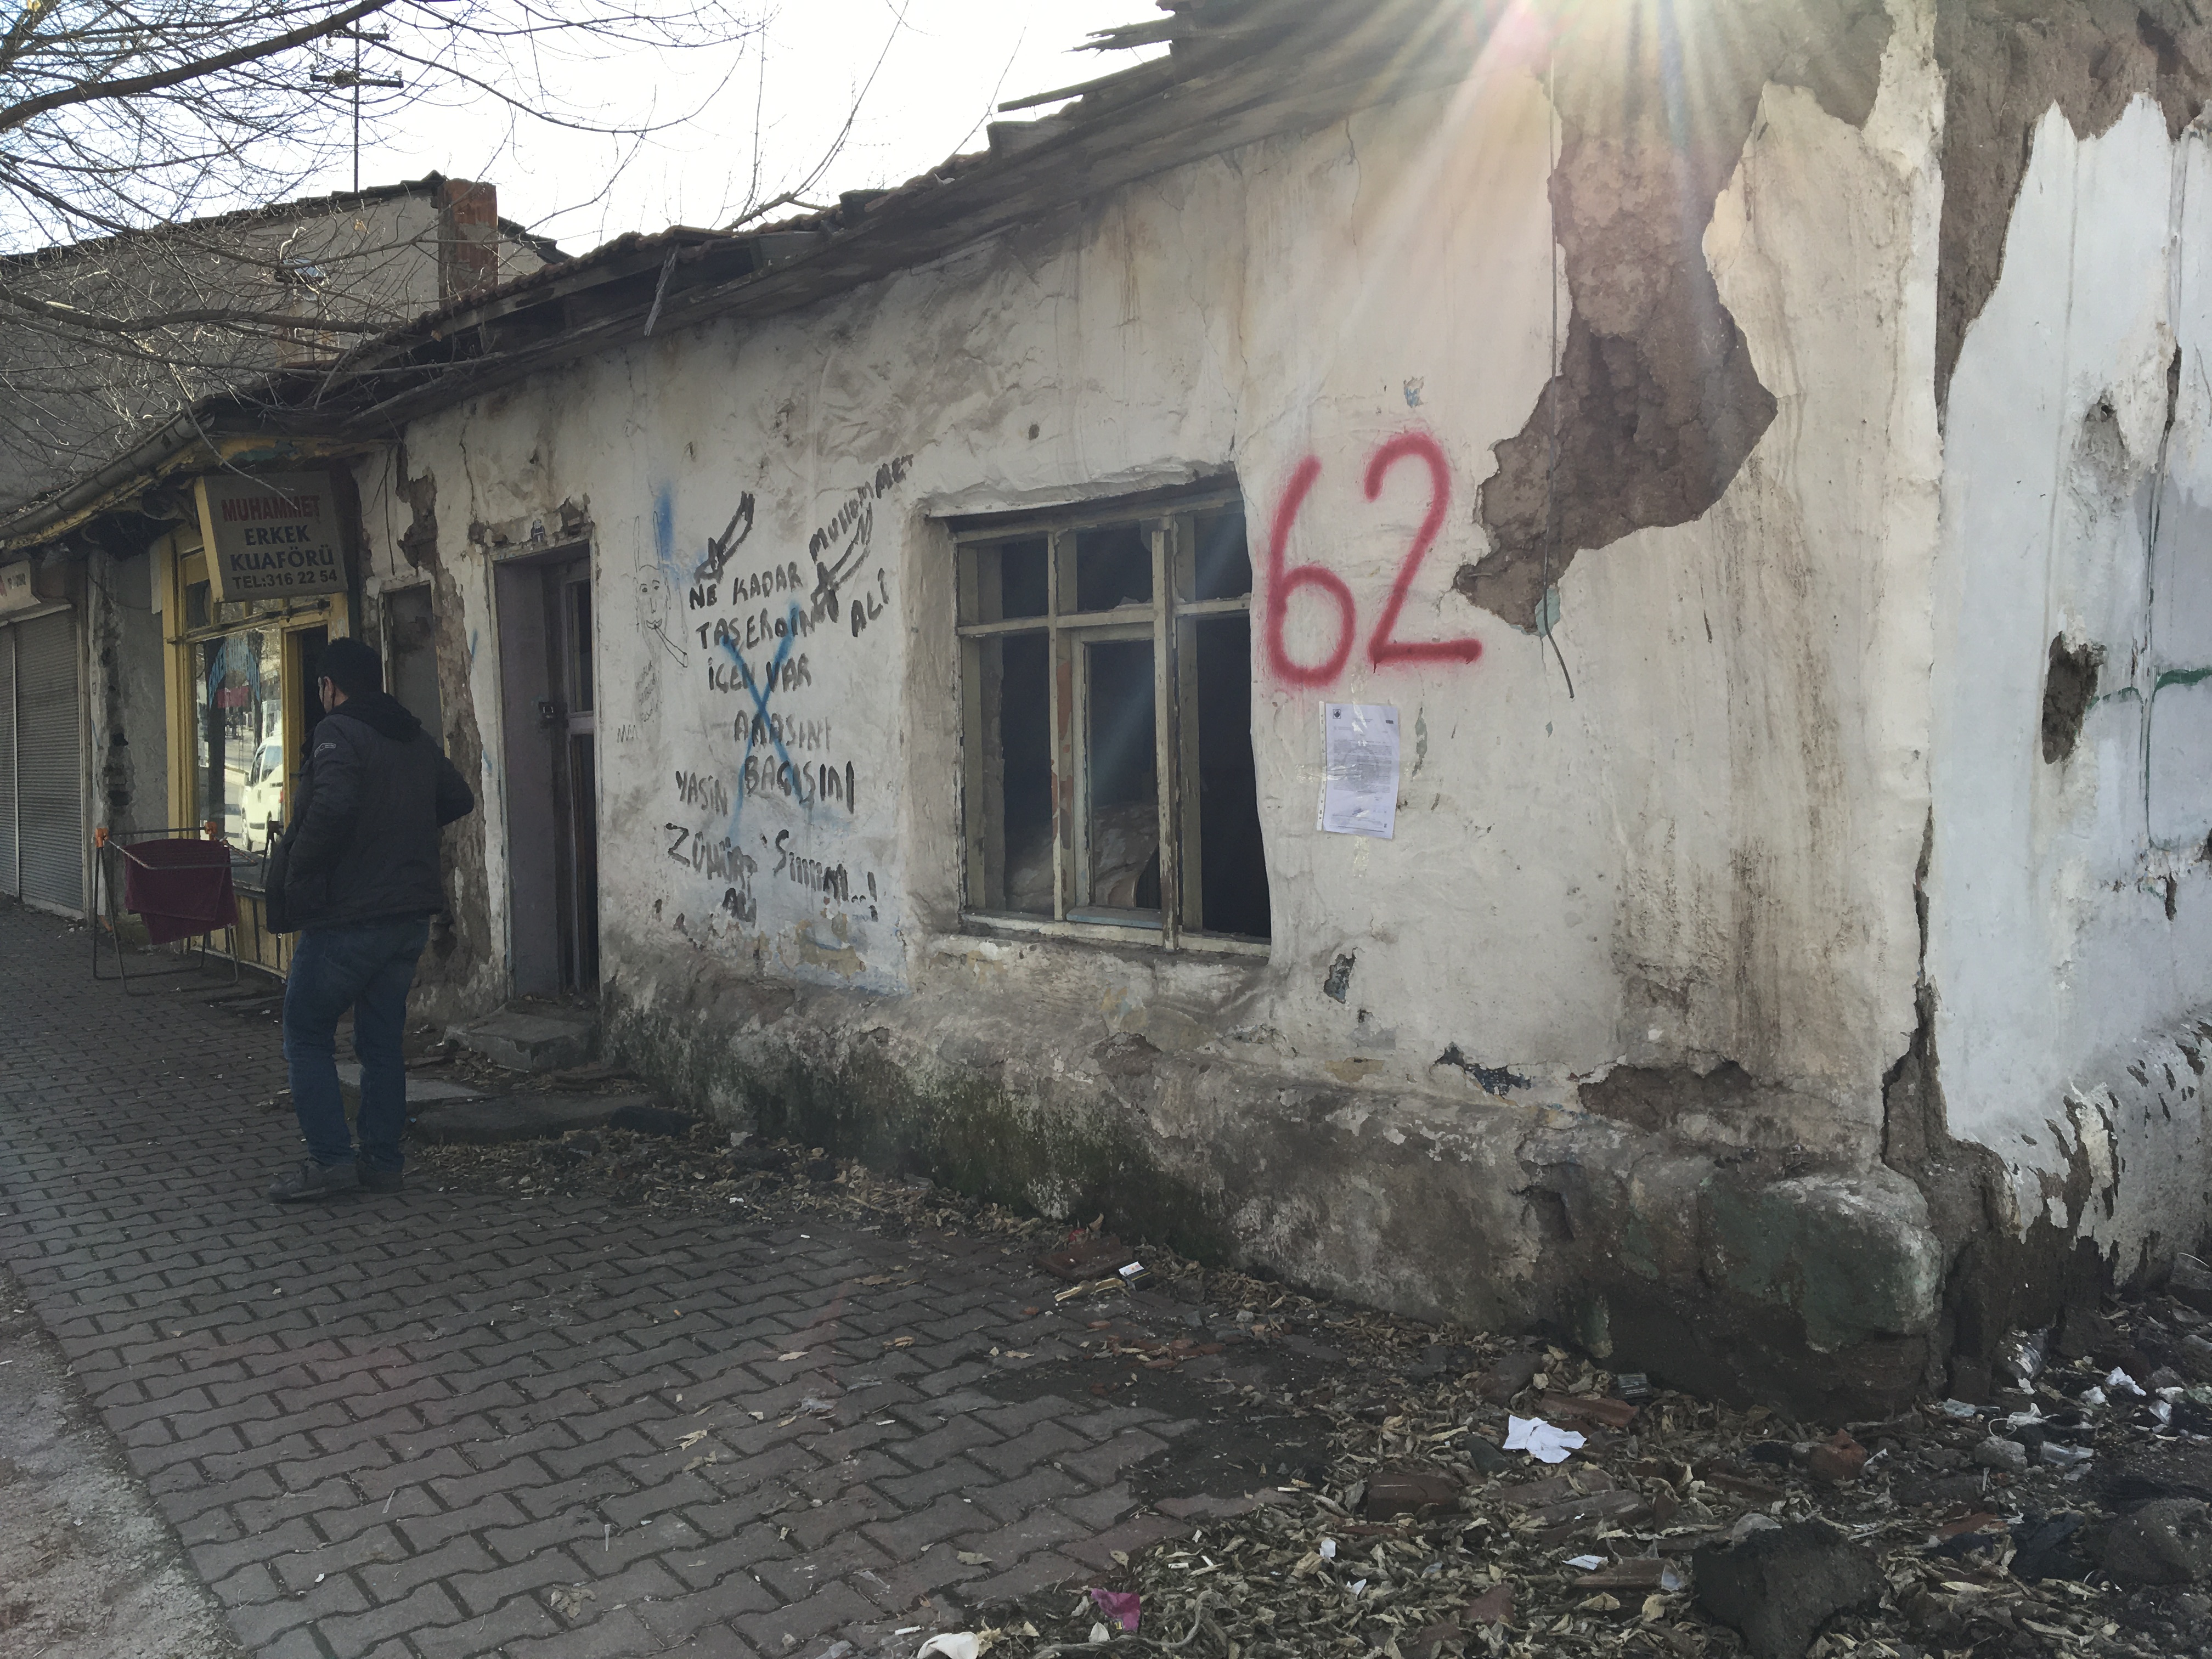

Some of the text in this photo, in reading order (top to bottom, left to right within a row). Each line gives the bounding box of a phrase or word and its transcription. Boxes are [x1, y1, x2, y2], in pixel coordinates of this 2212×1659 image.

[221, 495, 321, 522] MUHAMMET
[244, 524, 311, 546] ERKEK
[229, 544, 334, 571] KUAFÖRÜ
[1264, 431, 1483, 689] 62
[298, 571, 316, 584] 22
[320, 568, 337, 583] 54
[689, 561, 803, 610] NE KADAR
[766, 653, 812, 693] VAR
